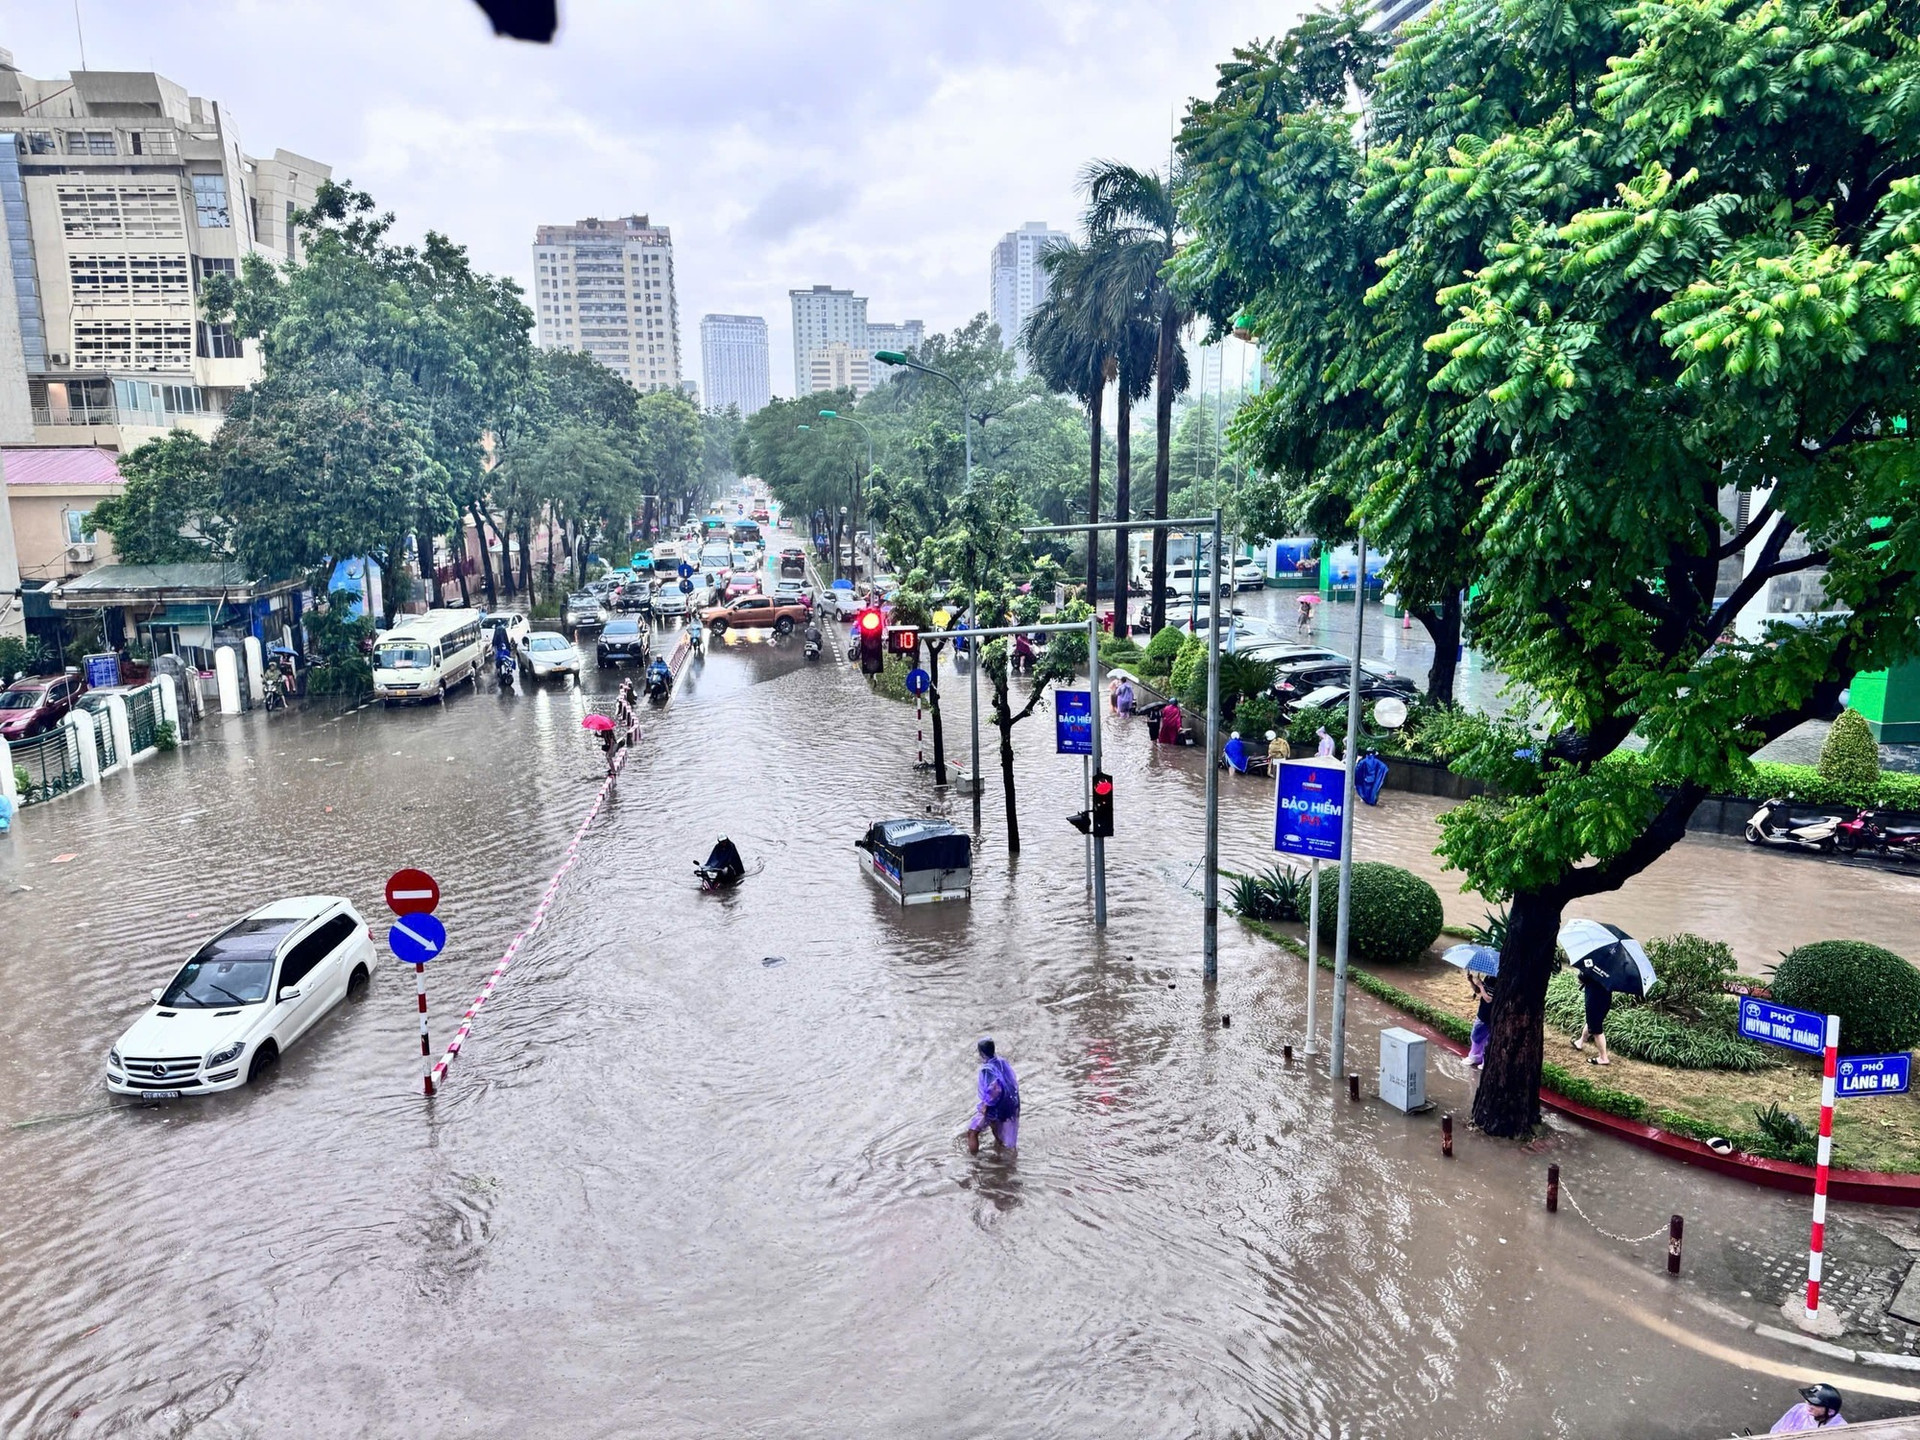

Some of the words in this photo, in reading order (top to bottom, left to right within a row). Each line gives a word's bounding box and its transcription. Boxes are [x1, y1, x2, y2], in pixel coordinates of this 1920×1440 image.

[900, 632, 914, 649] 10
[1058, 712, 1076, 723] BẢO
[1077, 712, 1091, 723] HIỂ
[1281, 795, 1308, 811] BẢO
[1311, 799, 1342, 816] HIỂM
[1770, 1012, 1795, 1023] PHỐ
[1745, 1016, 1771, 1036] HUỲNH
[1772, 1023, 1792, 1041] THÚC
[1792, 1029, 1819, 1048] KHÁNG
[1861, 1060, 1884, 1071] PHỐ
[1843, 1073, 1878, 1090] LÁNG
[1881, 1073, 1900, 1089] HẠ
